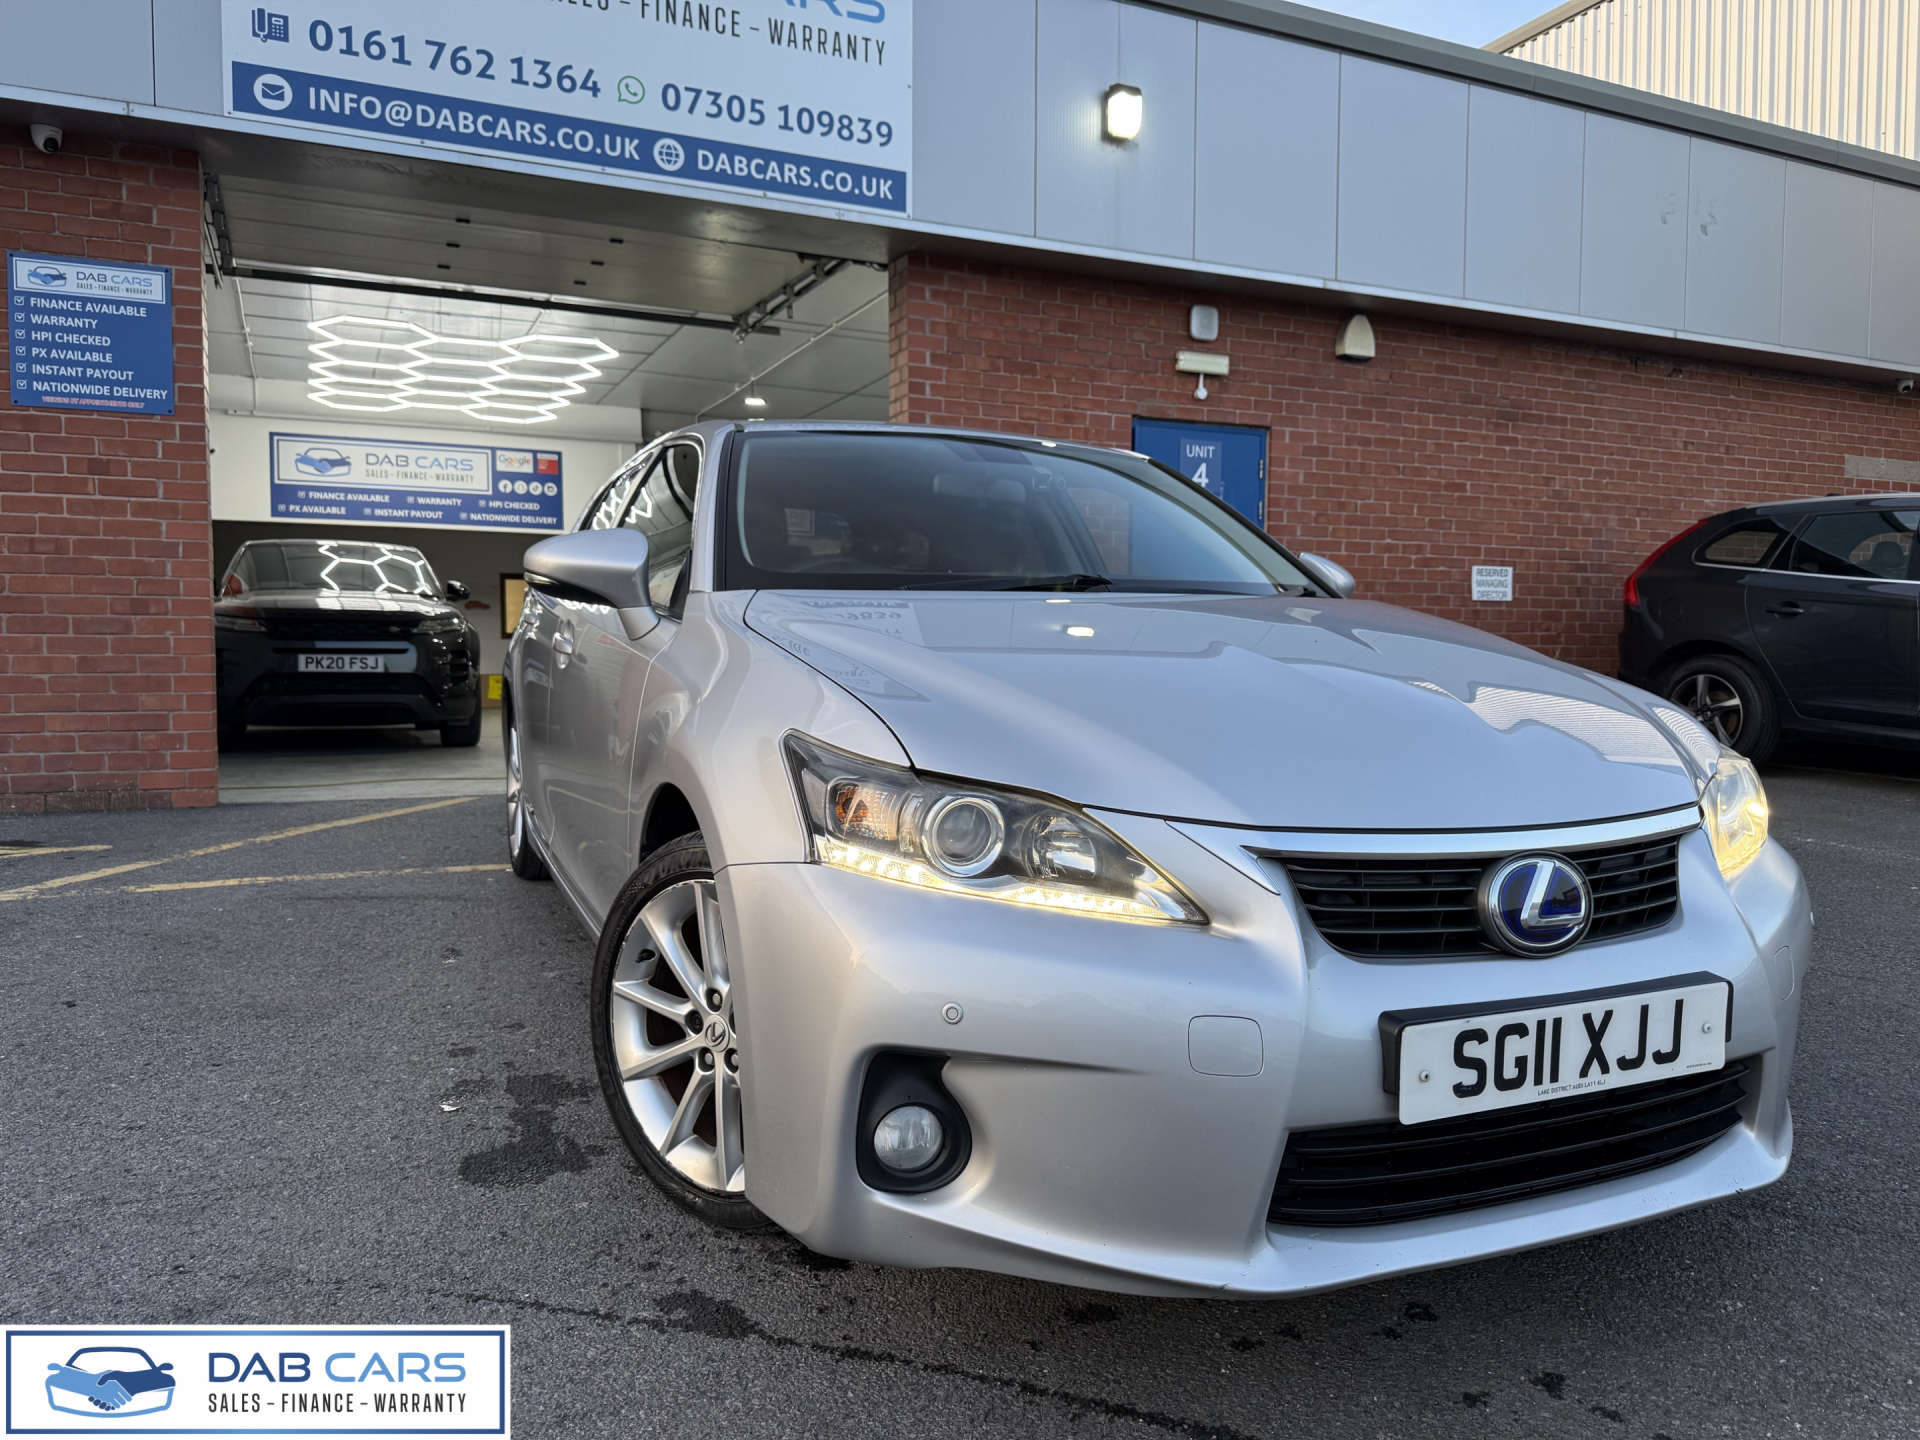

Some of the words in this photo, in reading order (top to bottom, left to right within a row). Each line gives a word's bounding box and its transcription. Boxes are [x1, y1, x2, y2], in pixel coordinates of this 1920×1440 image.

[641, 0, 741, 38] FINANCE
[768, 17, 886, 66] WARRANTY
[308, 19, 412, 66] 0161
[424, 39, 496, 81] 762
[509, 56, 601, 98] 1364
[308, 86, 641, 161] INFO@DABCARS.CO.UK
[661, 83, 766, 126] 07305
[777, 104, 893, 148] 109839
[696, 149, 894, 200] DABCARS.CO.UK
[76, 271, 108, 283] DAB
[110, 275, 153, 287] CARS
[30, 297, 83, 312] FINANCE
[85, 302, 148, 318] AVAILABLE
[30, 313, 98, 329] WARRANTY
[31, 330, 52, 342] HPI
[55, 332, 111, 347] CHECKED
[32, 347, 48, 358] PX
[50, 349, 113, 363] AVAILABLE
[32, 364, 83, 378] INSTANT
[86, 368, 134, 381] PAYOUT
[32, 381, 111, 396] NATIONWIDE
[113, 387, 168, 400] DELIVERY
[1186, 444, 1215, 459] UNIT
[365, 453, 410, 467] DAB
[415, 455, 474, 471] CARS
[1191, 462, 1209, 488] 4
[309, 491, 345, 500] FINANCE
[347, 493, 390, 503] AVAILABLE
[416, 497, 462, 507] WARRANTY
[302, 505, 347, 515] AVAILABLE
[374, 508, 409, 517] INSTANT
[410, 510, 443, 519] PAYOUT
[488, 501, 503, 509] HPI
[504, 501, 541, 511] CHECKED
[469, 513, 521, 523] NATIONWIDE
[521, 515, 557, 525] DELIVERY
[1476, 567, 1509, 577] RESERVED
[304, 656, 345, 670] PK20
[349, 657, 379, 670] FSJ
[1452, 1017, 1563, 1099] SG11
[1578, 998, 1685, 1079] XJJ
